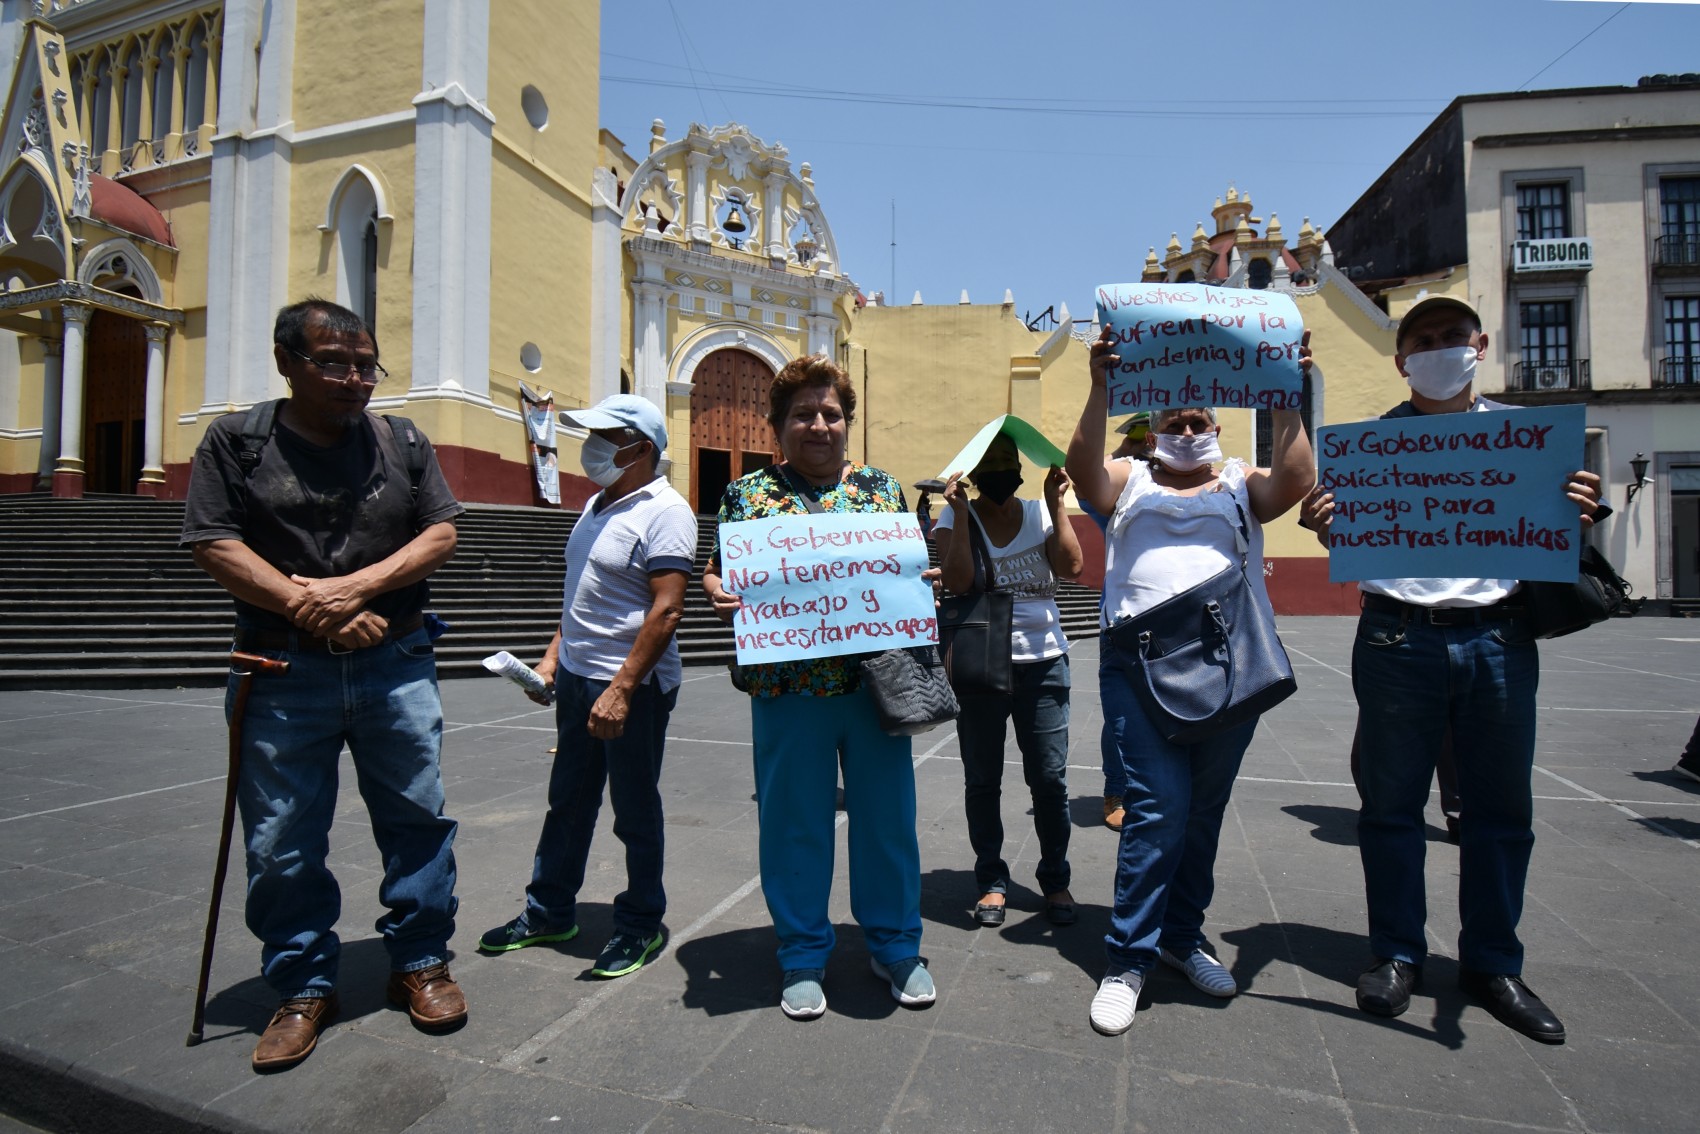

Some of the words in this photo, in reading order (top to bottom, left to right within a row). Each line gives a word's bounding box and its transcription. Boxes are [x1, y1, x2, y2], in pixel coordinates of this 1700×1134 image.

[1516, 241, 1590, 265] TRIBUNA
[1205, 286, 1269, 309] hijos
[1258, 311, 1287, 333] la
[1108, 377, 1170, 411] Falta
[1178, 374, 1205, 406] de
[1323, 432, 1355, 459] Sr.
[1357, 419, 1555, 457] Gobernador
[1332, 496, 1412, 523] apoyo
[726, 533, 764, 561] Sr.
[767, 521, 925, 552] Gobernador
[1329, 523, 1449, 549] nuestras
[1455, 516, 1572, 551] familias
[728, 567, 770, 593] No
[777, 553, 902, 585] tenemos
[1006, 550, 1042, 571] WITH
[993, 568, 1036, 586] OUR
[861, 589, 881, 613] y
